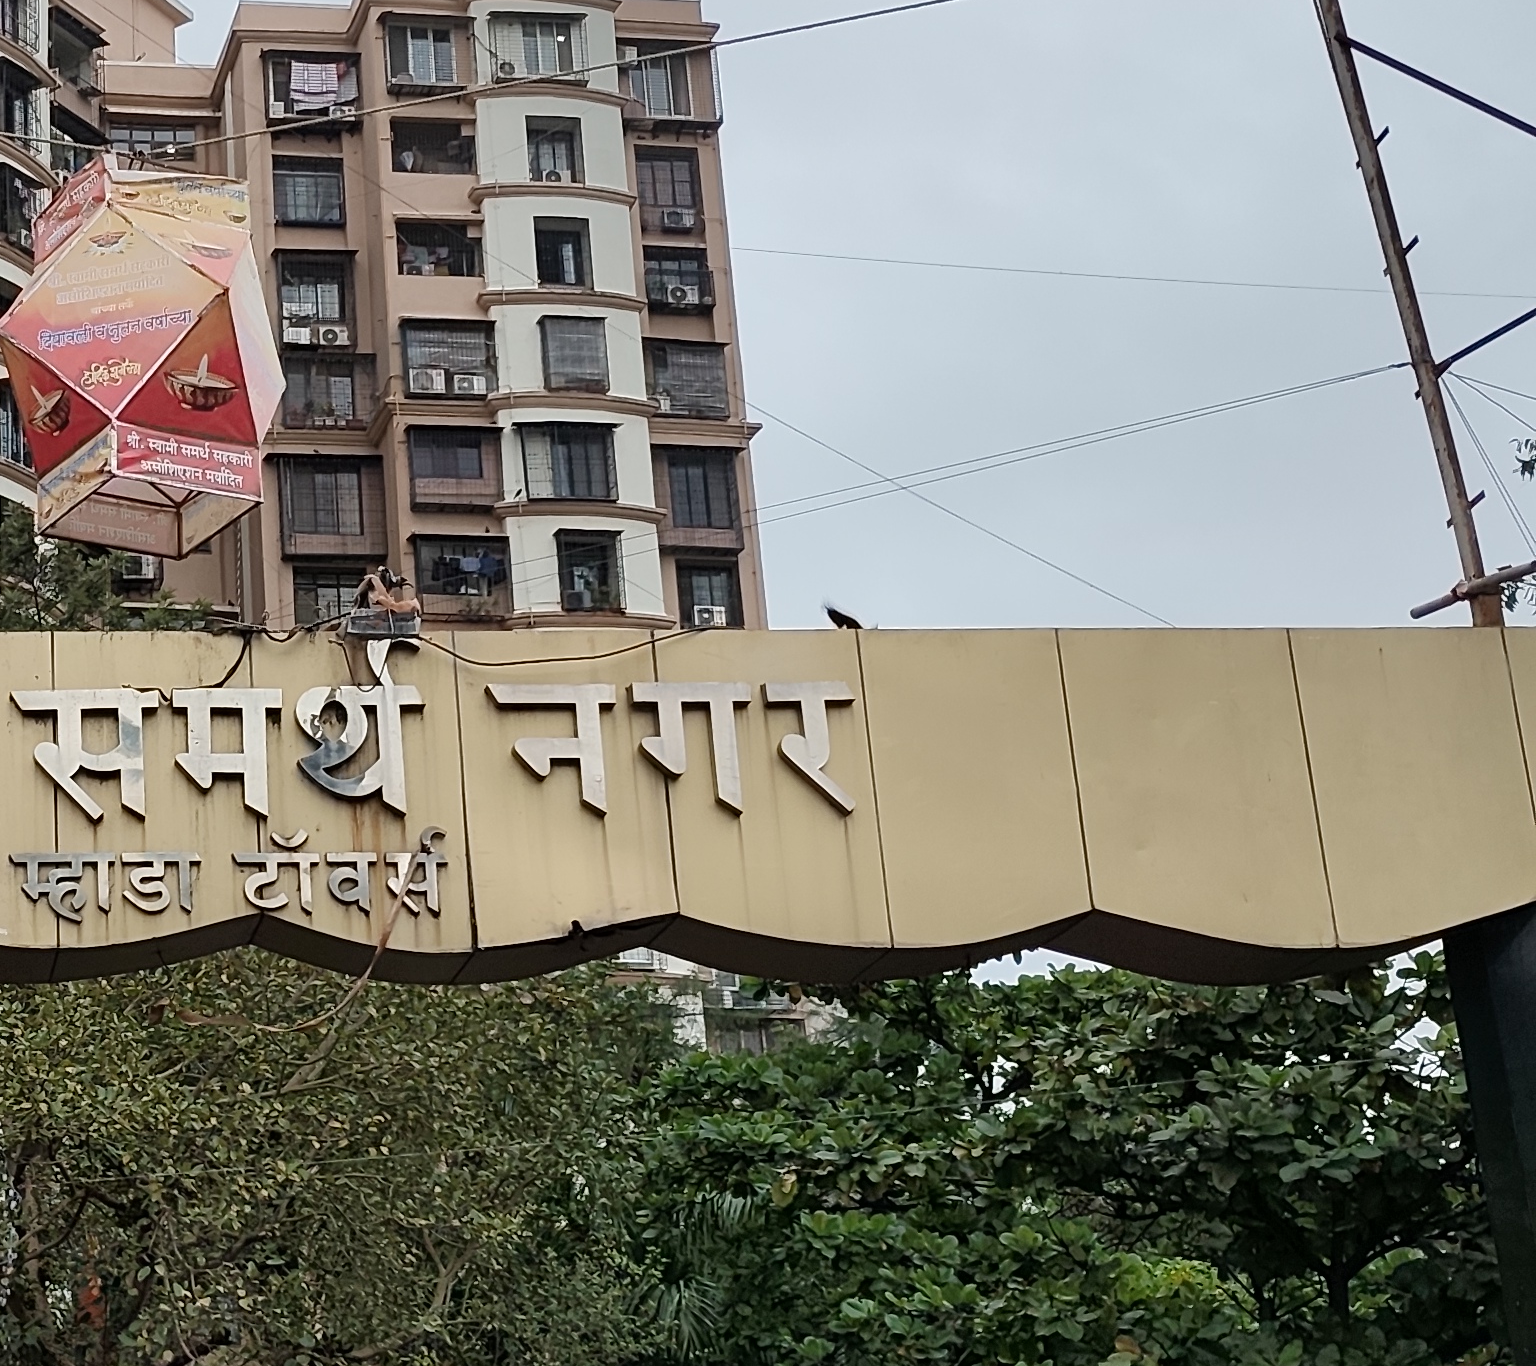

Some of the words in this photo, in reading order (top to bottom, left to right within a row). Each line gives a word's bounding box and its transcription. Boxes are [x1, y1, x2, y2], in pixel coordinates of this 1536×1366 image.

[93, 324, 108, 340] व
[143, 306, 194, 331] वर्षाच्या
[146, 437, 178, 456] स्वामी
[179, 441, 210, 461] समर्थ
[212, 449, 253, 469] सहकारी
[140, 457, 203, 481] असोशिएशन
[205, 466, 244, 489] मर्यादित
[9, 638, 426, 822] समर्थ
[484, 680, 856, 817] नगर
[9, 852, 202, 923] म्हाडा
[233, 826, 448, 916] टॉवर्स
